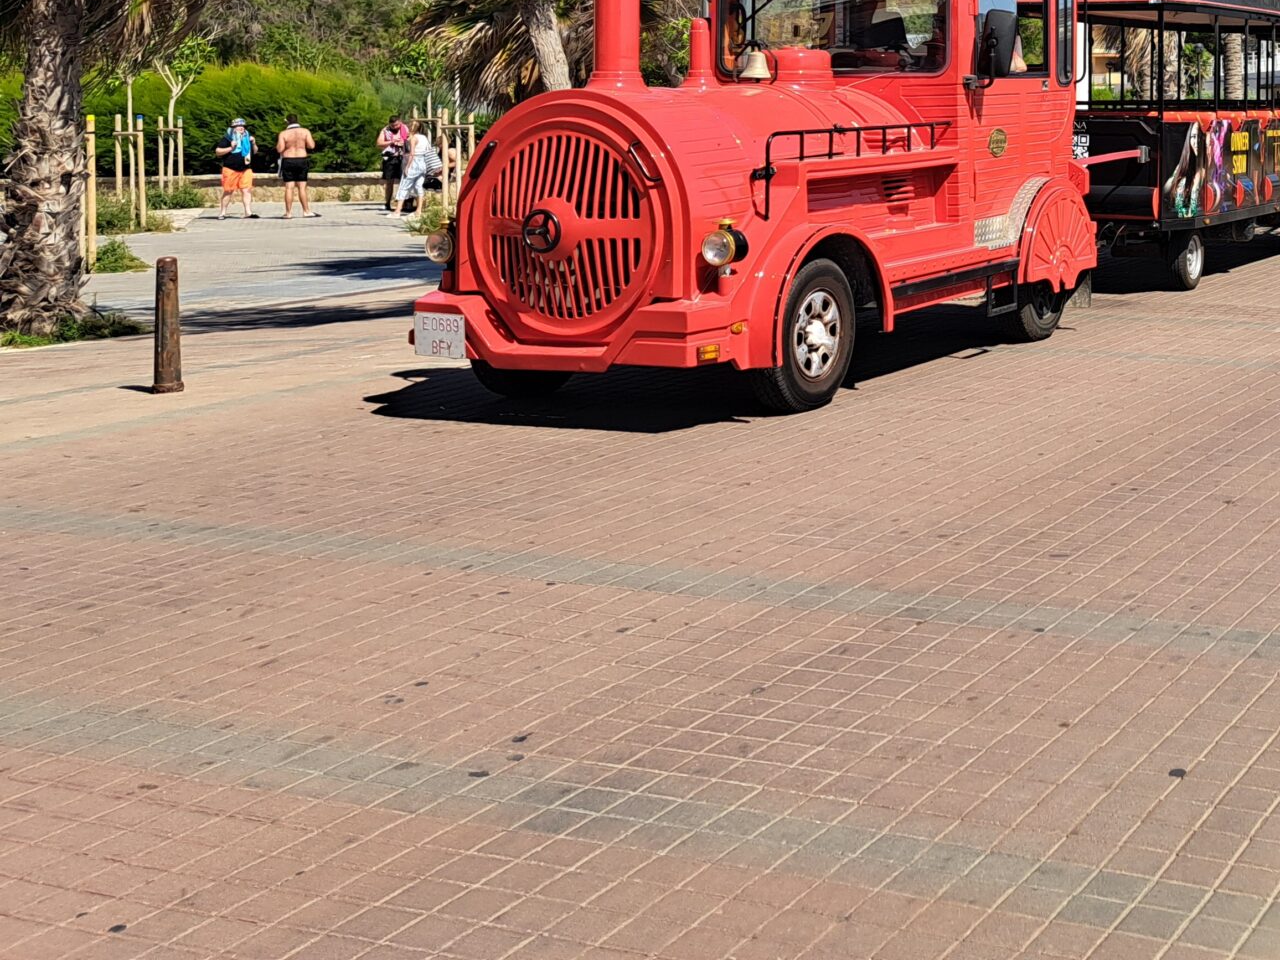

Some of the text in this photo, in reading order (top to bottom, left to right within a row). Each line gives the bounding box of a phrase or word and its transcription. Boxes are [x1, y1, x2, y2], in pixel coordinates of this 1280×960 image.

[1231, 131, 1249, 151] DINNER
[1232, 154, 1247, 174] SHOW
[422, 316, 460, 333] E0689
[431, 339, 453, 356] BFY
